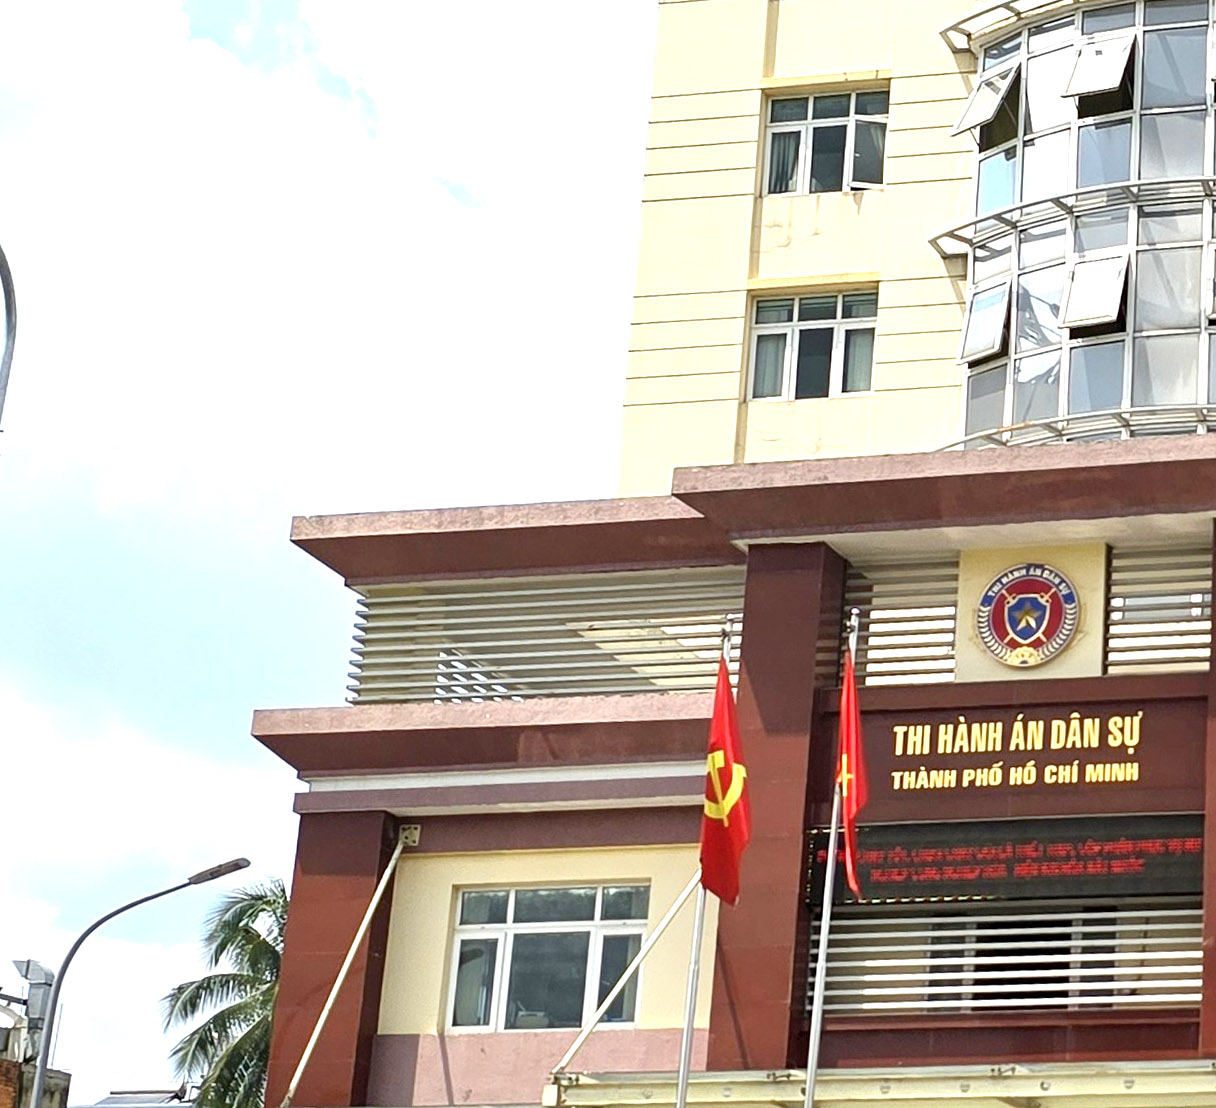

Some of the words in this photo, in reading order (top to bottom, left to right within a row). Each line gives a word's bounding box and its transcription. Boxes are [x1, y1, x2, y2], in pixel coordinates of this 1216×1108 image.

[893, 724, 931, 756] THI
[937, 715, 1003, 754] HÀNH
[1009, 713, 1044, 751] ÁN
[1050, 711, 1100, 750] DÂN
[1107, 710, 1143, 755] SỰ
[891, 766, 957, 790] THÀNH
[962, 761, 1004, 788] PHỐ
[1044, 760, 1079, 785] CHÍ
[1085, 762, 1139, 783] MINH
